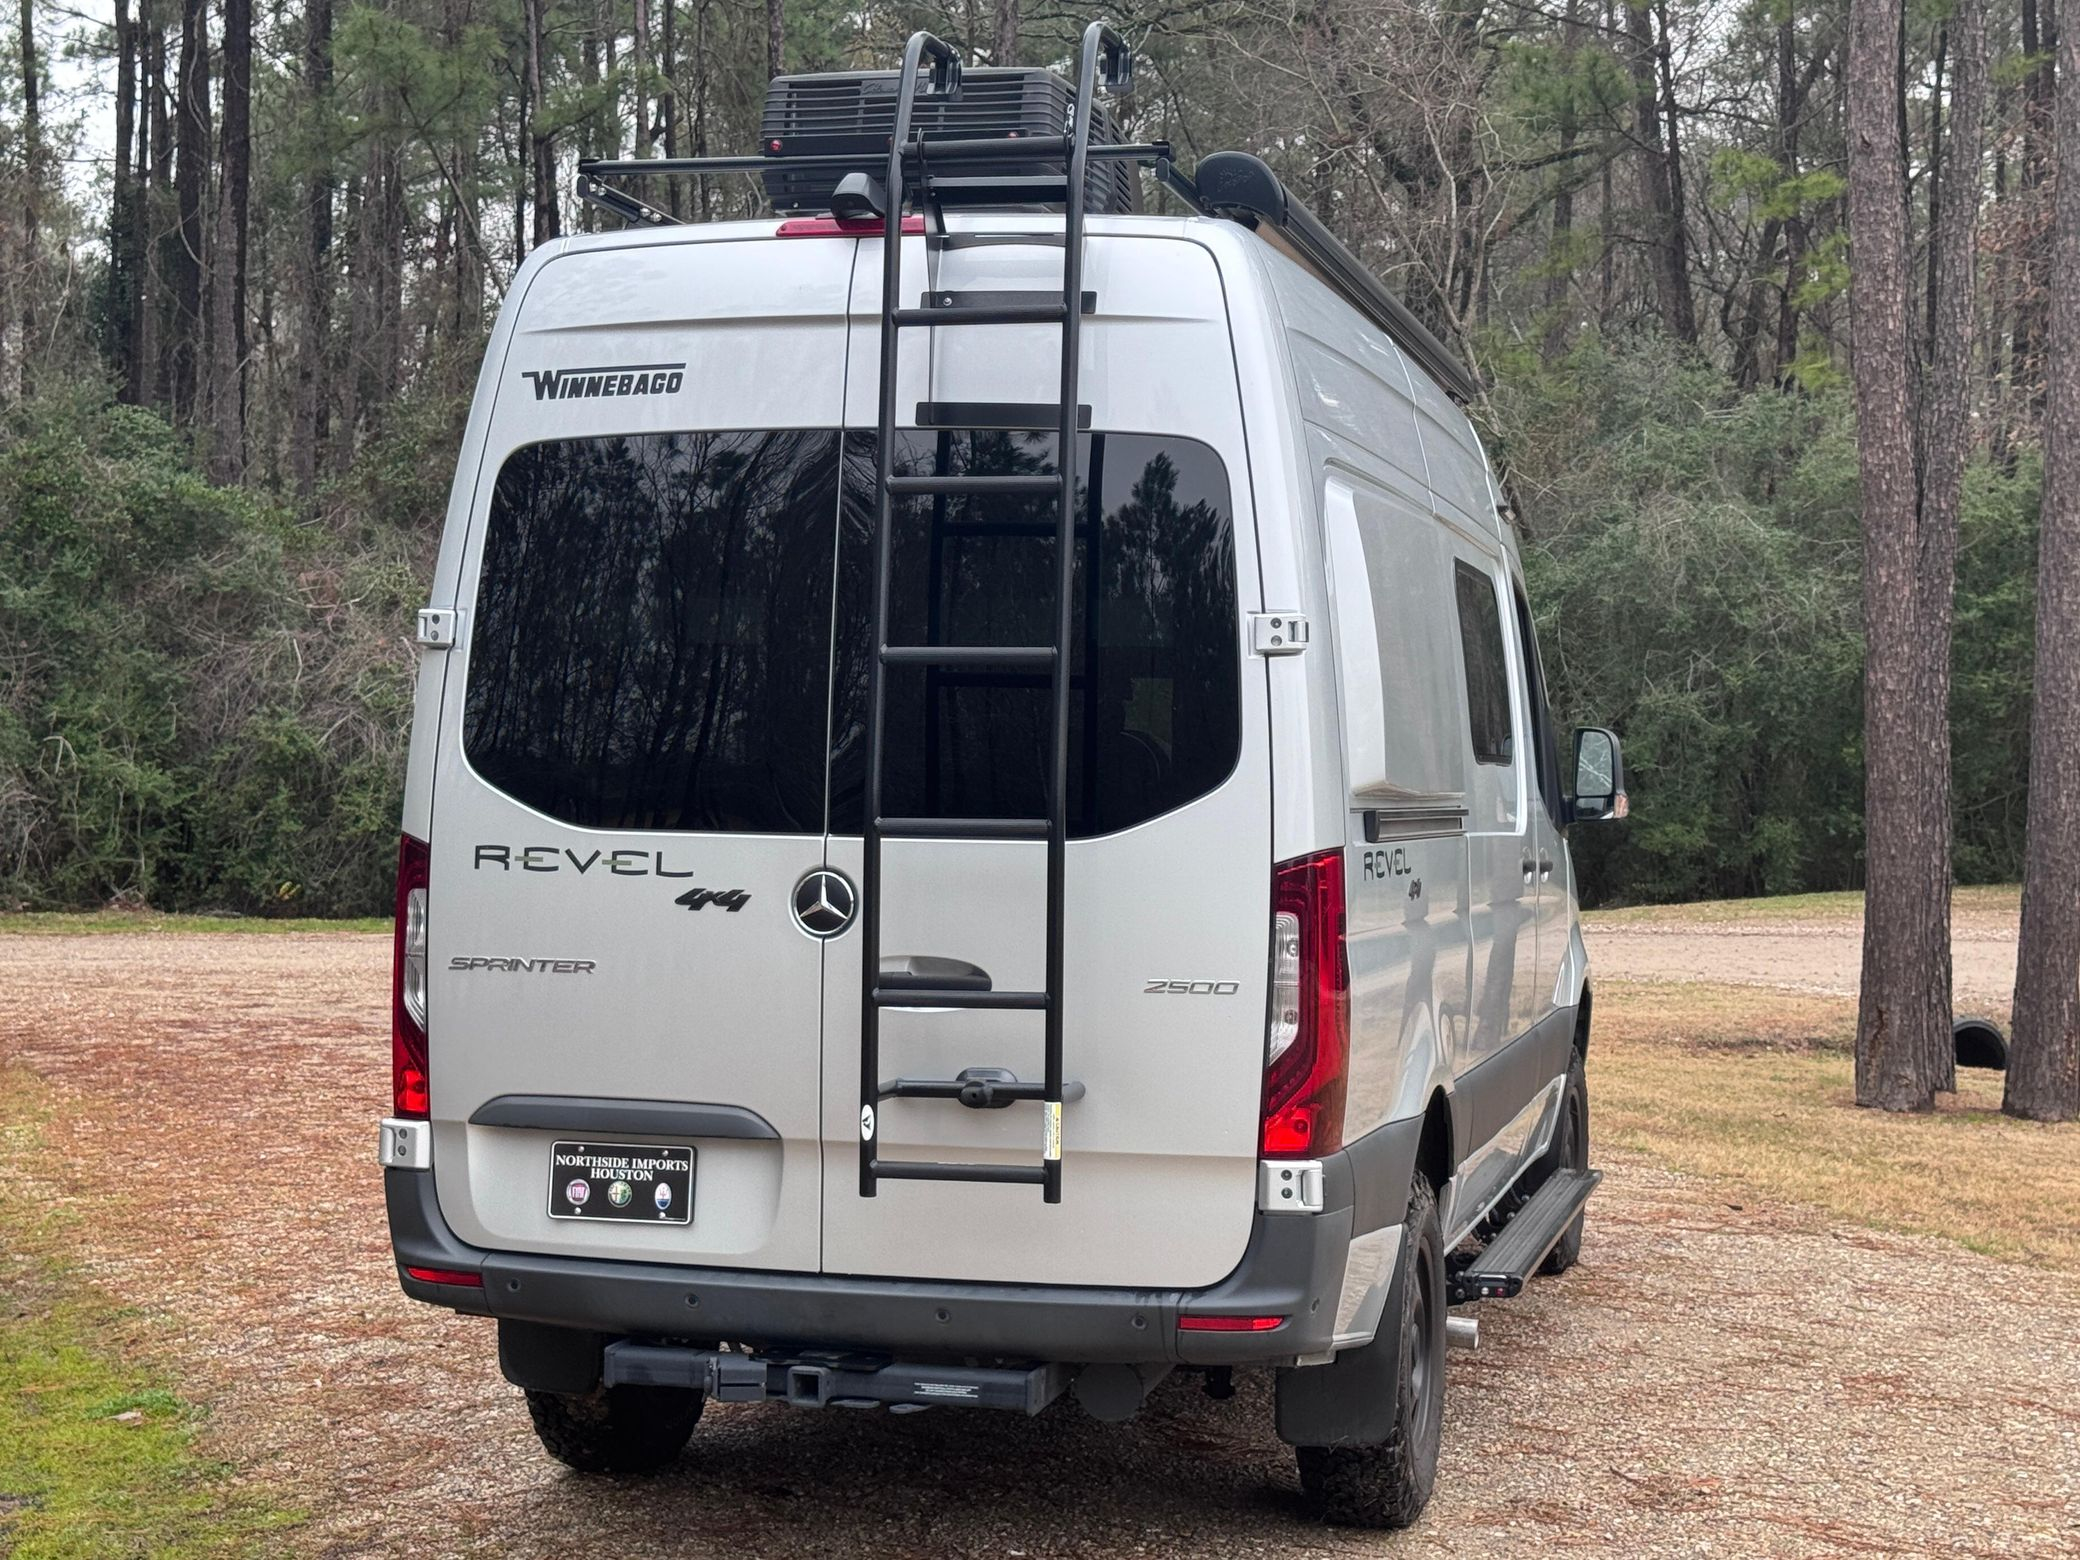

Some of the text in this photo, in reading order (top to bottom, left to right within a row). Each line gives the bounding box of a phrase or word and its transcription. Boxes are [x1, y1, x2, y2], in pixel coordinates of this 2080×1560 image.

[521, 363, 687, 401] WINNEBAGO
[474, 844, 695, 878] REVEL
[1363, 847, 1412, 881] REVEL
[448, 956, 598, 975] SPRINTER
[1143, 979, 1241, 995] 2500
[555, 1154, 689, 1172] NORTHSIDE IMPORTS
[590, 1167, 654, 1182] HOUSTON
